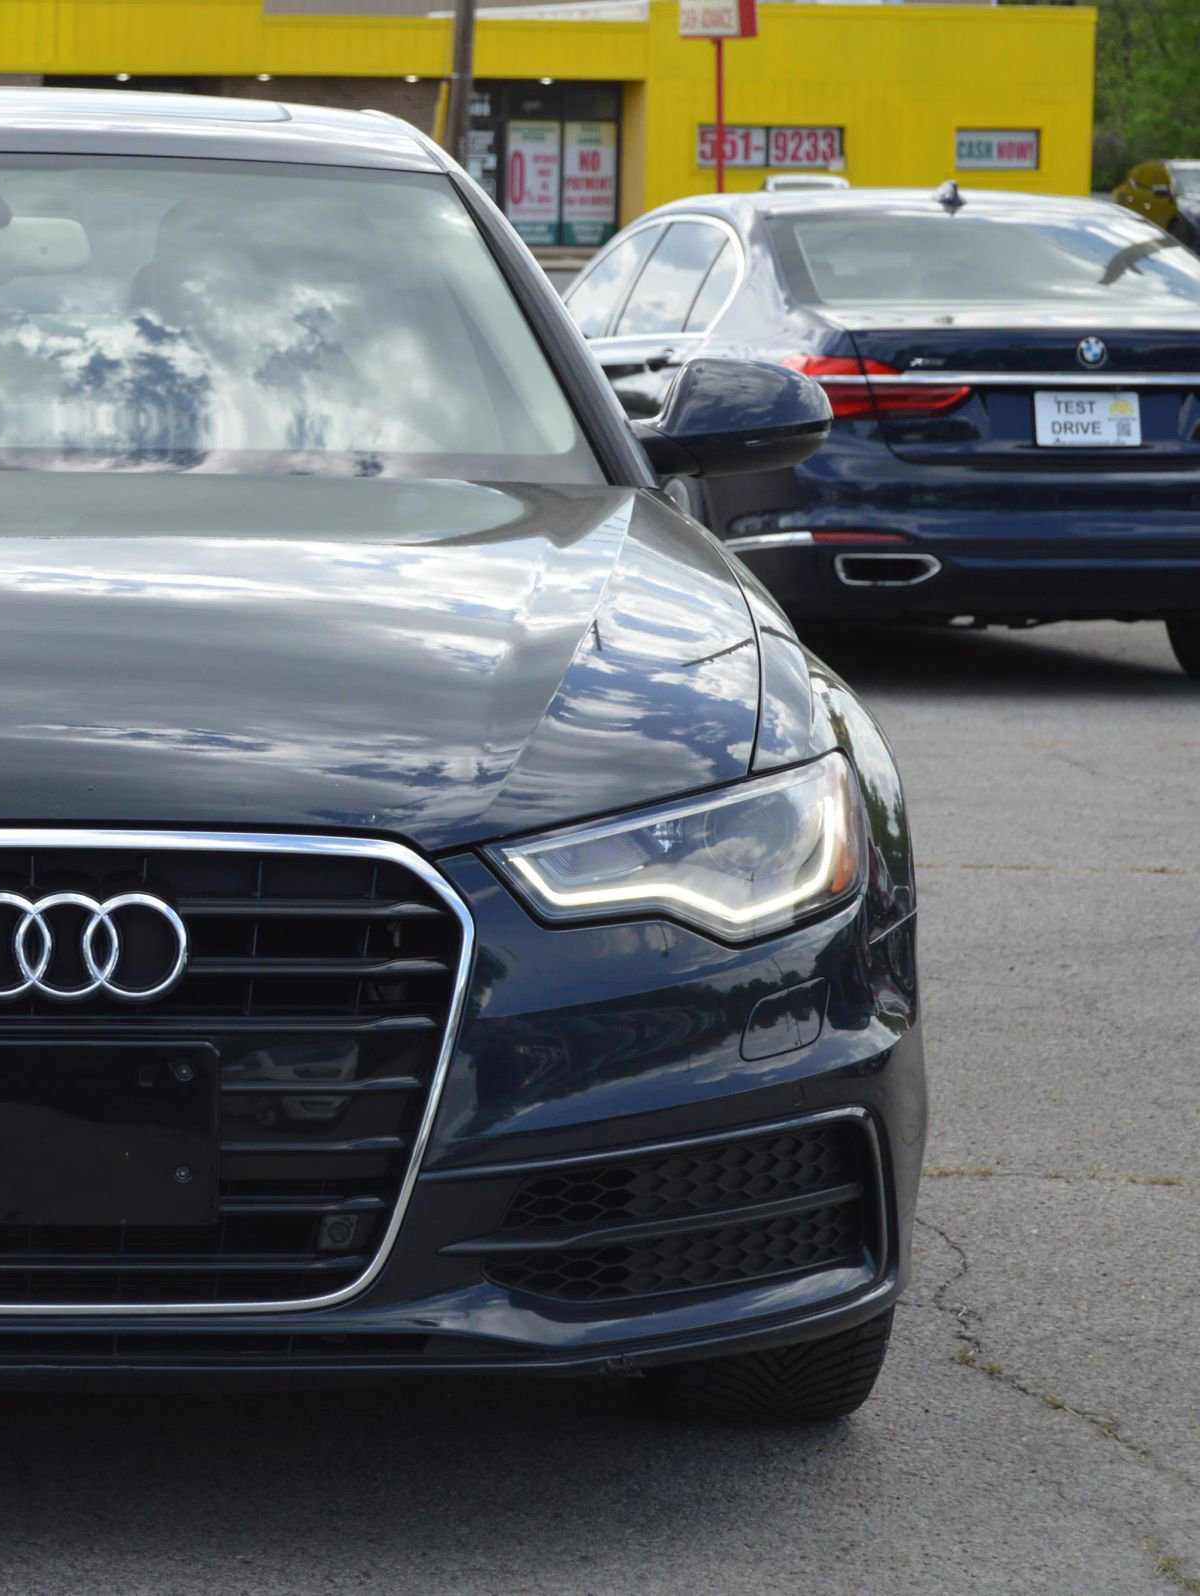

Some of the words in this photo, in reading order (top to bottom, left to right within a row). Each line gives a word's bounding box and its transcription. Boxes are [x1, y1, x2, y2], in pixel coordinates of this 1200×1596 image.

[773, 131, 836, 162] 9233
[957, 139, 993, 160] CASH
[578, 150, 601, 172] NO
[1056, 400, 1096, 415] TEST
[1051, 420, 1102, 436] DRIVE
